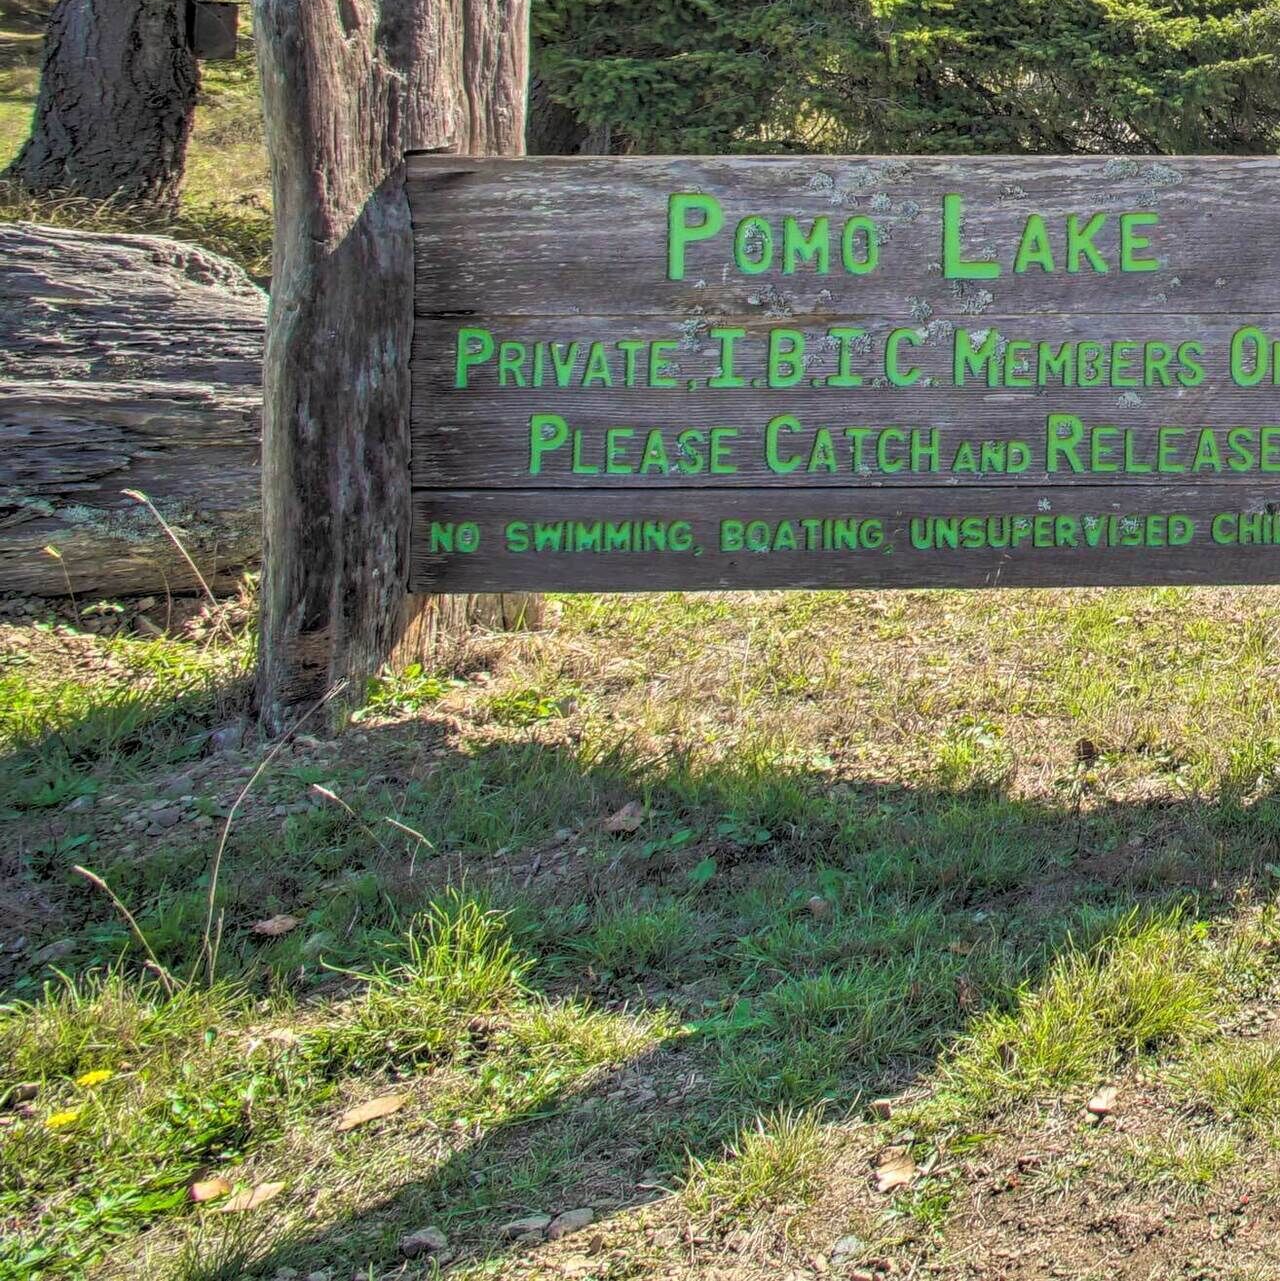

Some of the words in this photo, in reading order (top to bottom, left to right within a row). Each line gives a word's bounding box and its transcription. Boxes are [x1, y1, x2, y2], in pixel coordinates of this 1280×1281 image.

[667, 192, 879, 281] POMO
[942, 192, 1161, 281] LAKE
[952, 327, 1206, 388] MEMBERS
[528, 413, 740, 476] PLEASE
[764, 413, 941, 476] CATCH
[951, 439, 1033, 475] AND
[429, 519, 482, 554] NO
[504, 518, 705, 557] SWIMMING,
[909, 513, 1196, 551] UNSUPERVISED
